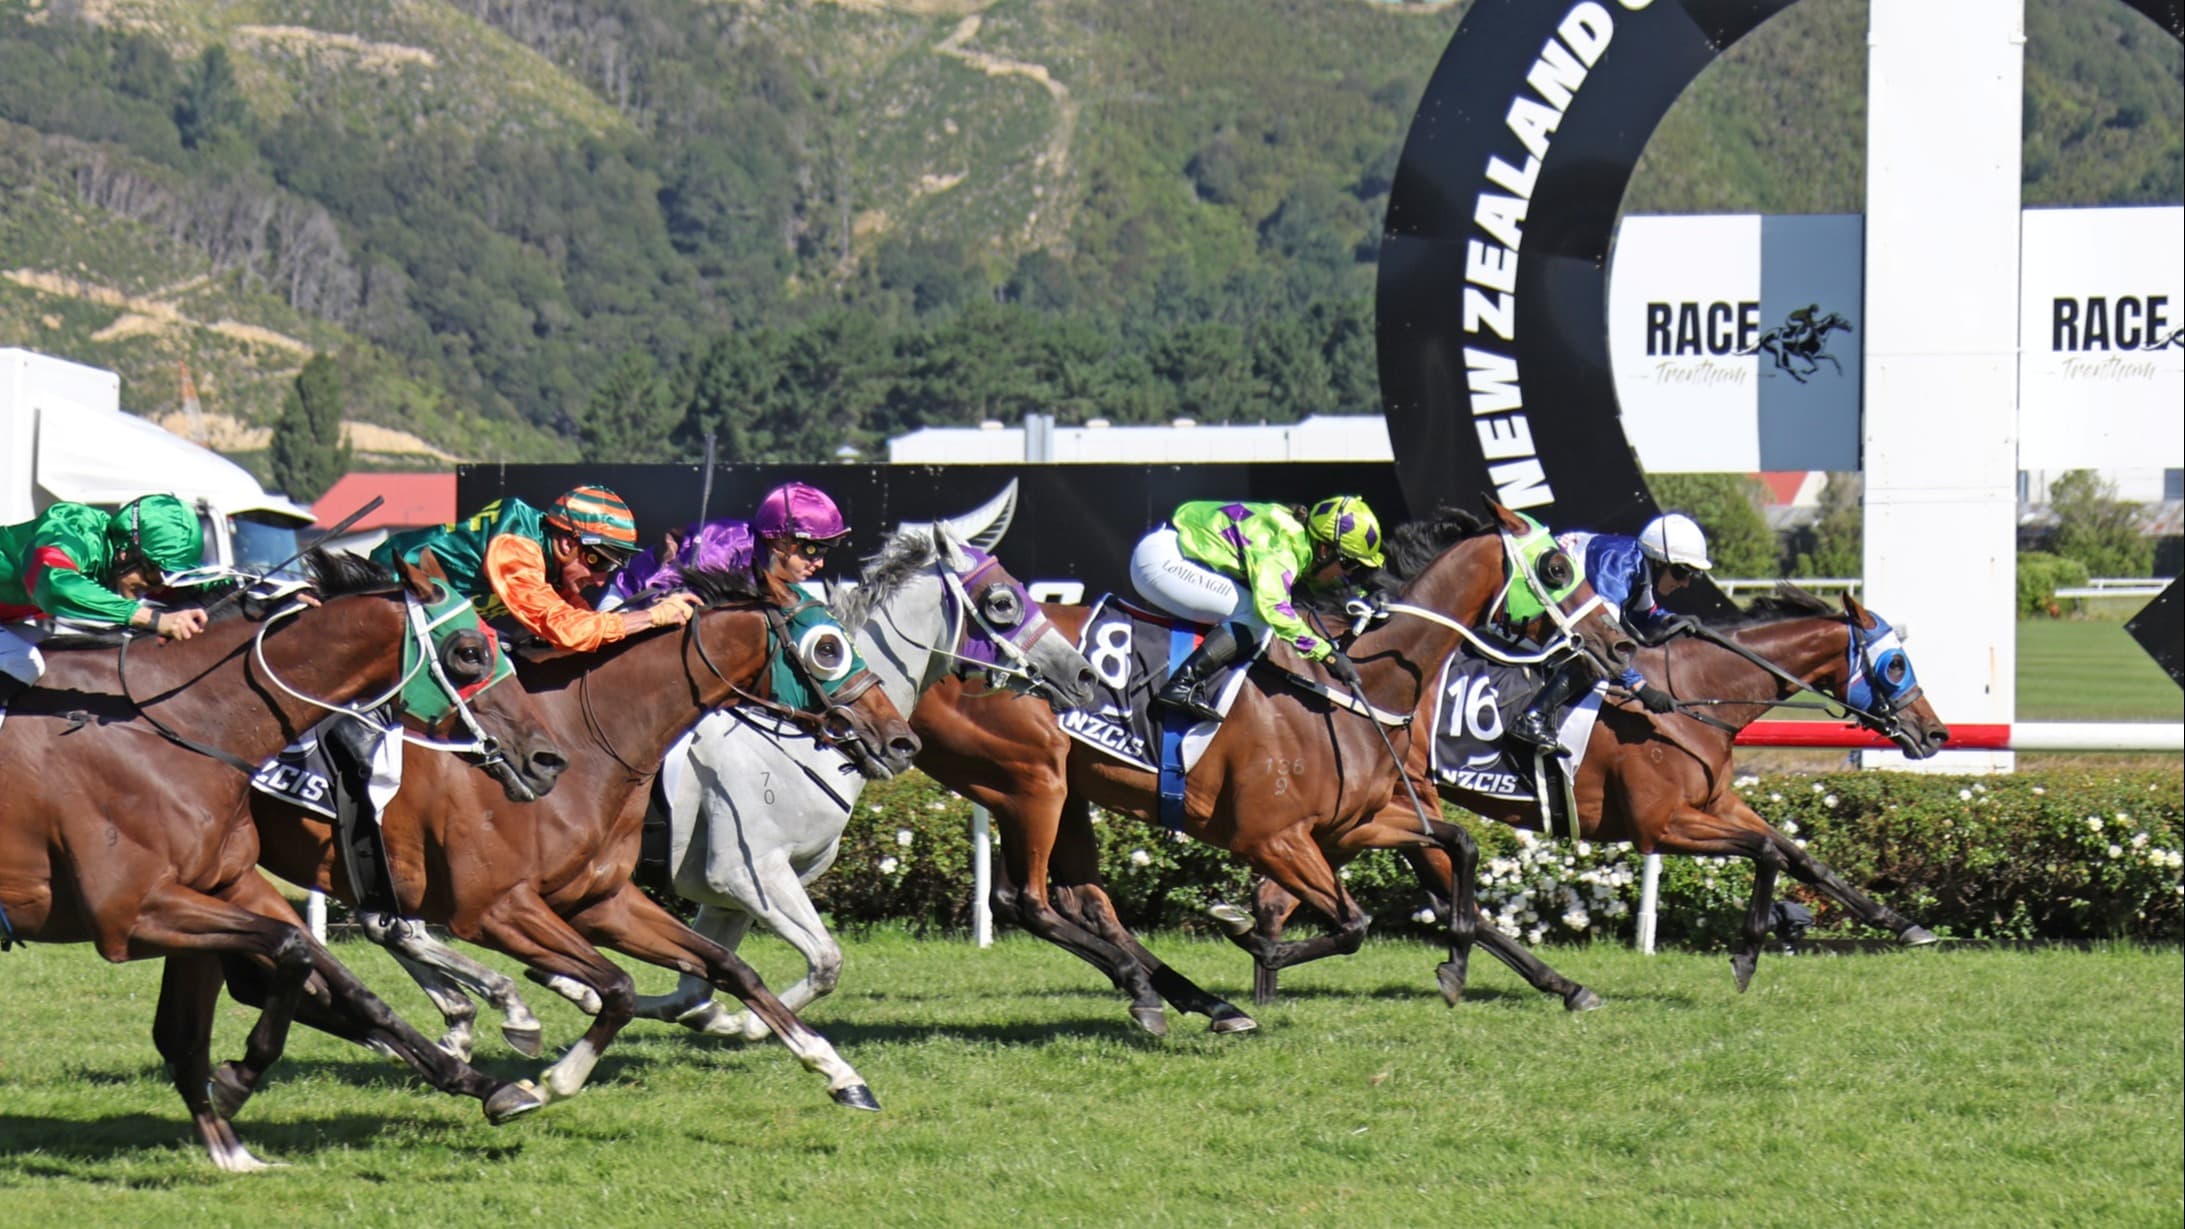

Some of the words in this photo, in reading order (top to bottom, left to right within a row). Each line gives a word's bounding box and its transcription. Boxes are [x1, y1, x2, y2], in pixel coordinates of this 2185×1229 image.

[1462, 1, 1614, 341] ZEALAND
[1646, 301, 1761, 356] RACE
[2052, 295, 2169, 352] RACE
[1463, 346, 1555, 511] NEW
[1090, 621, 1132, 690] 8
[1064, 709, 1145, 757] NZCIS
[1446, 675, 1504, 742] 16
[255, 759, 329, 802] ZCIS
[759, 771, 770, 787] 7
[1441, 768, 1518, 794] NZCIS
